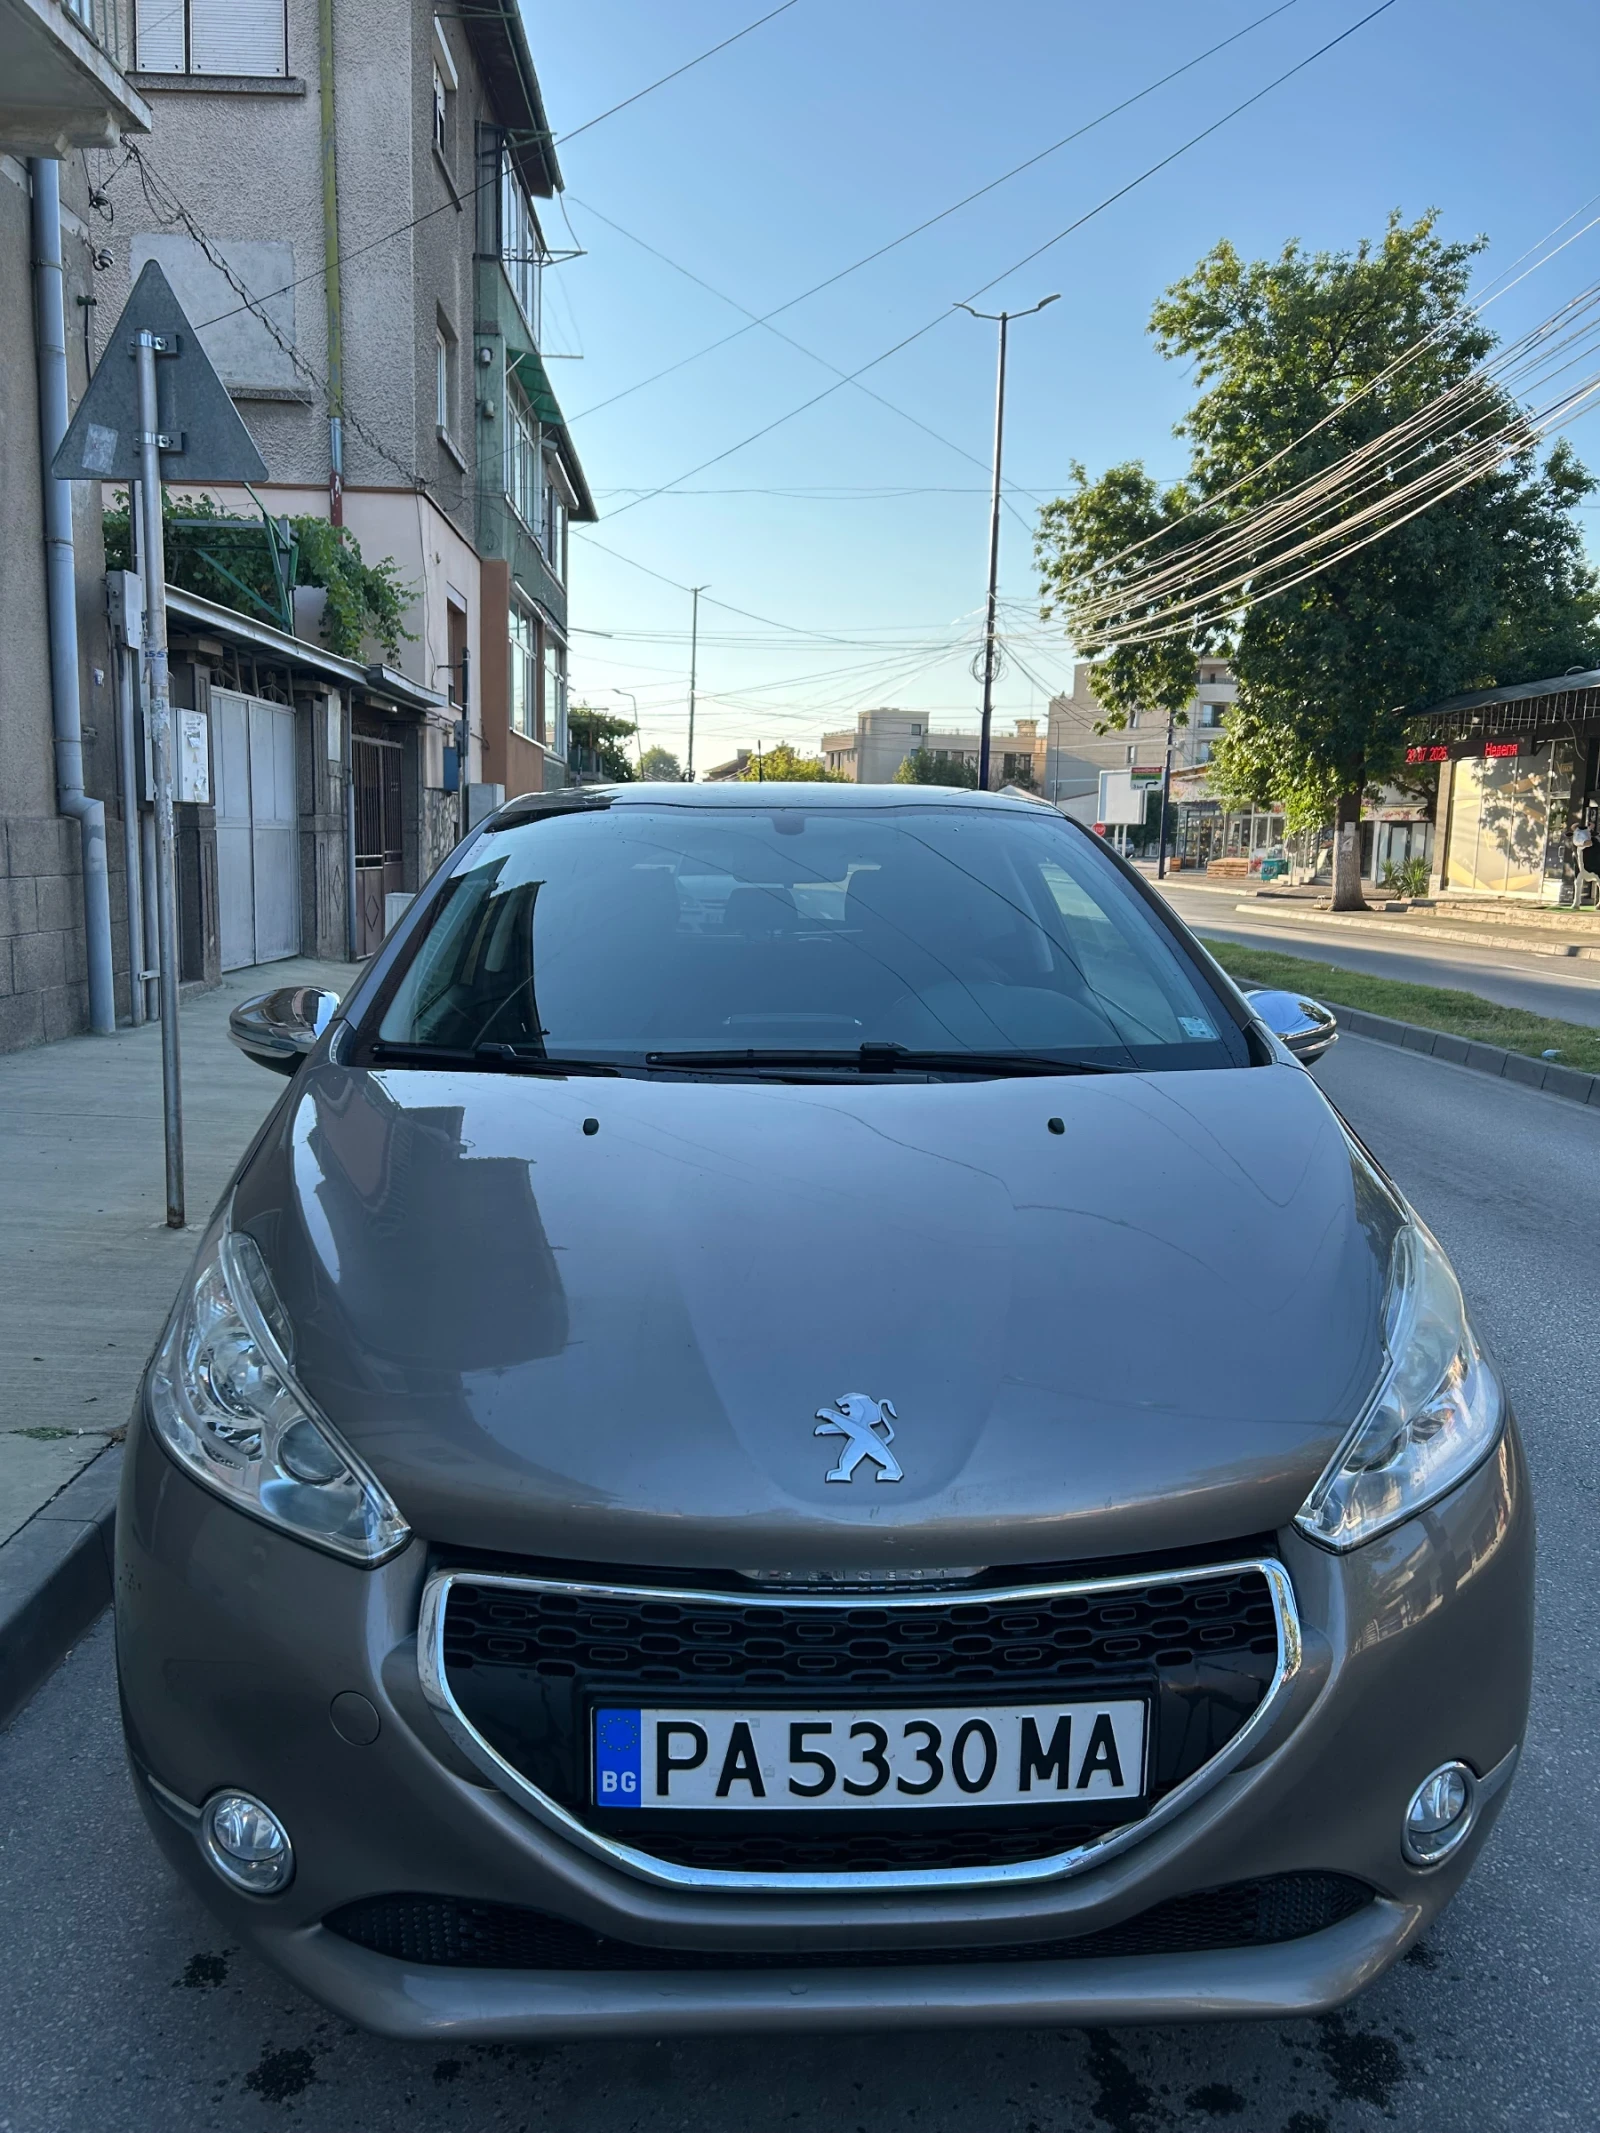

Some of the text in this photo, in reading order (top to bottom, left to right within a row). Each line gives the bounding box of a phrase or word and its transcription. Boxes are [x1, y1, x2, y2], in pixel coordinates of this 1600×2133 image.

[602, 1770, 637, 1793] BG
[656, 1711, 1126, 1798] PA 5330 MA
